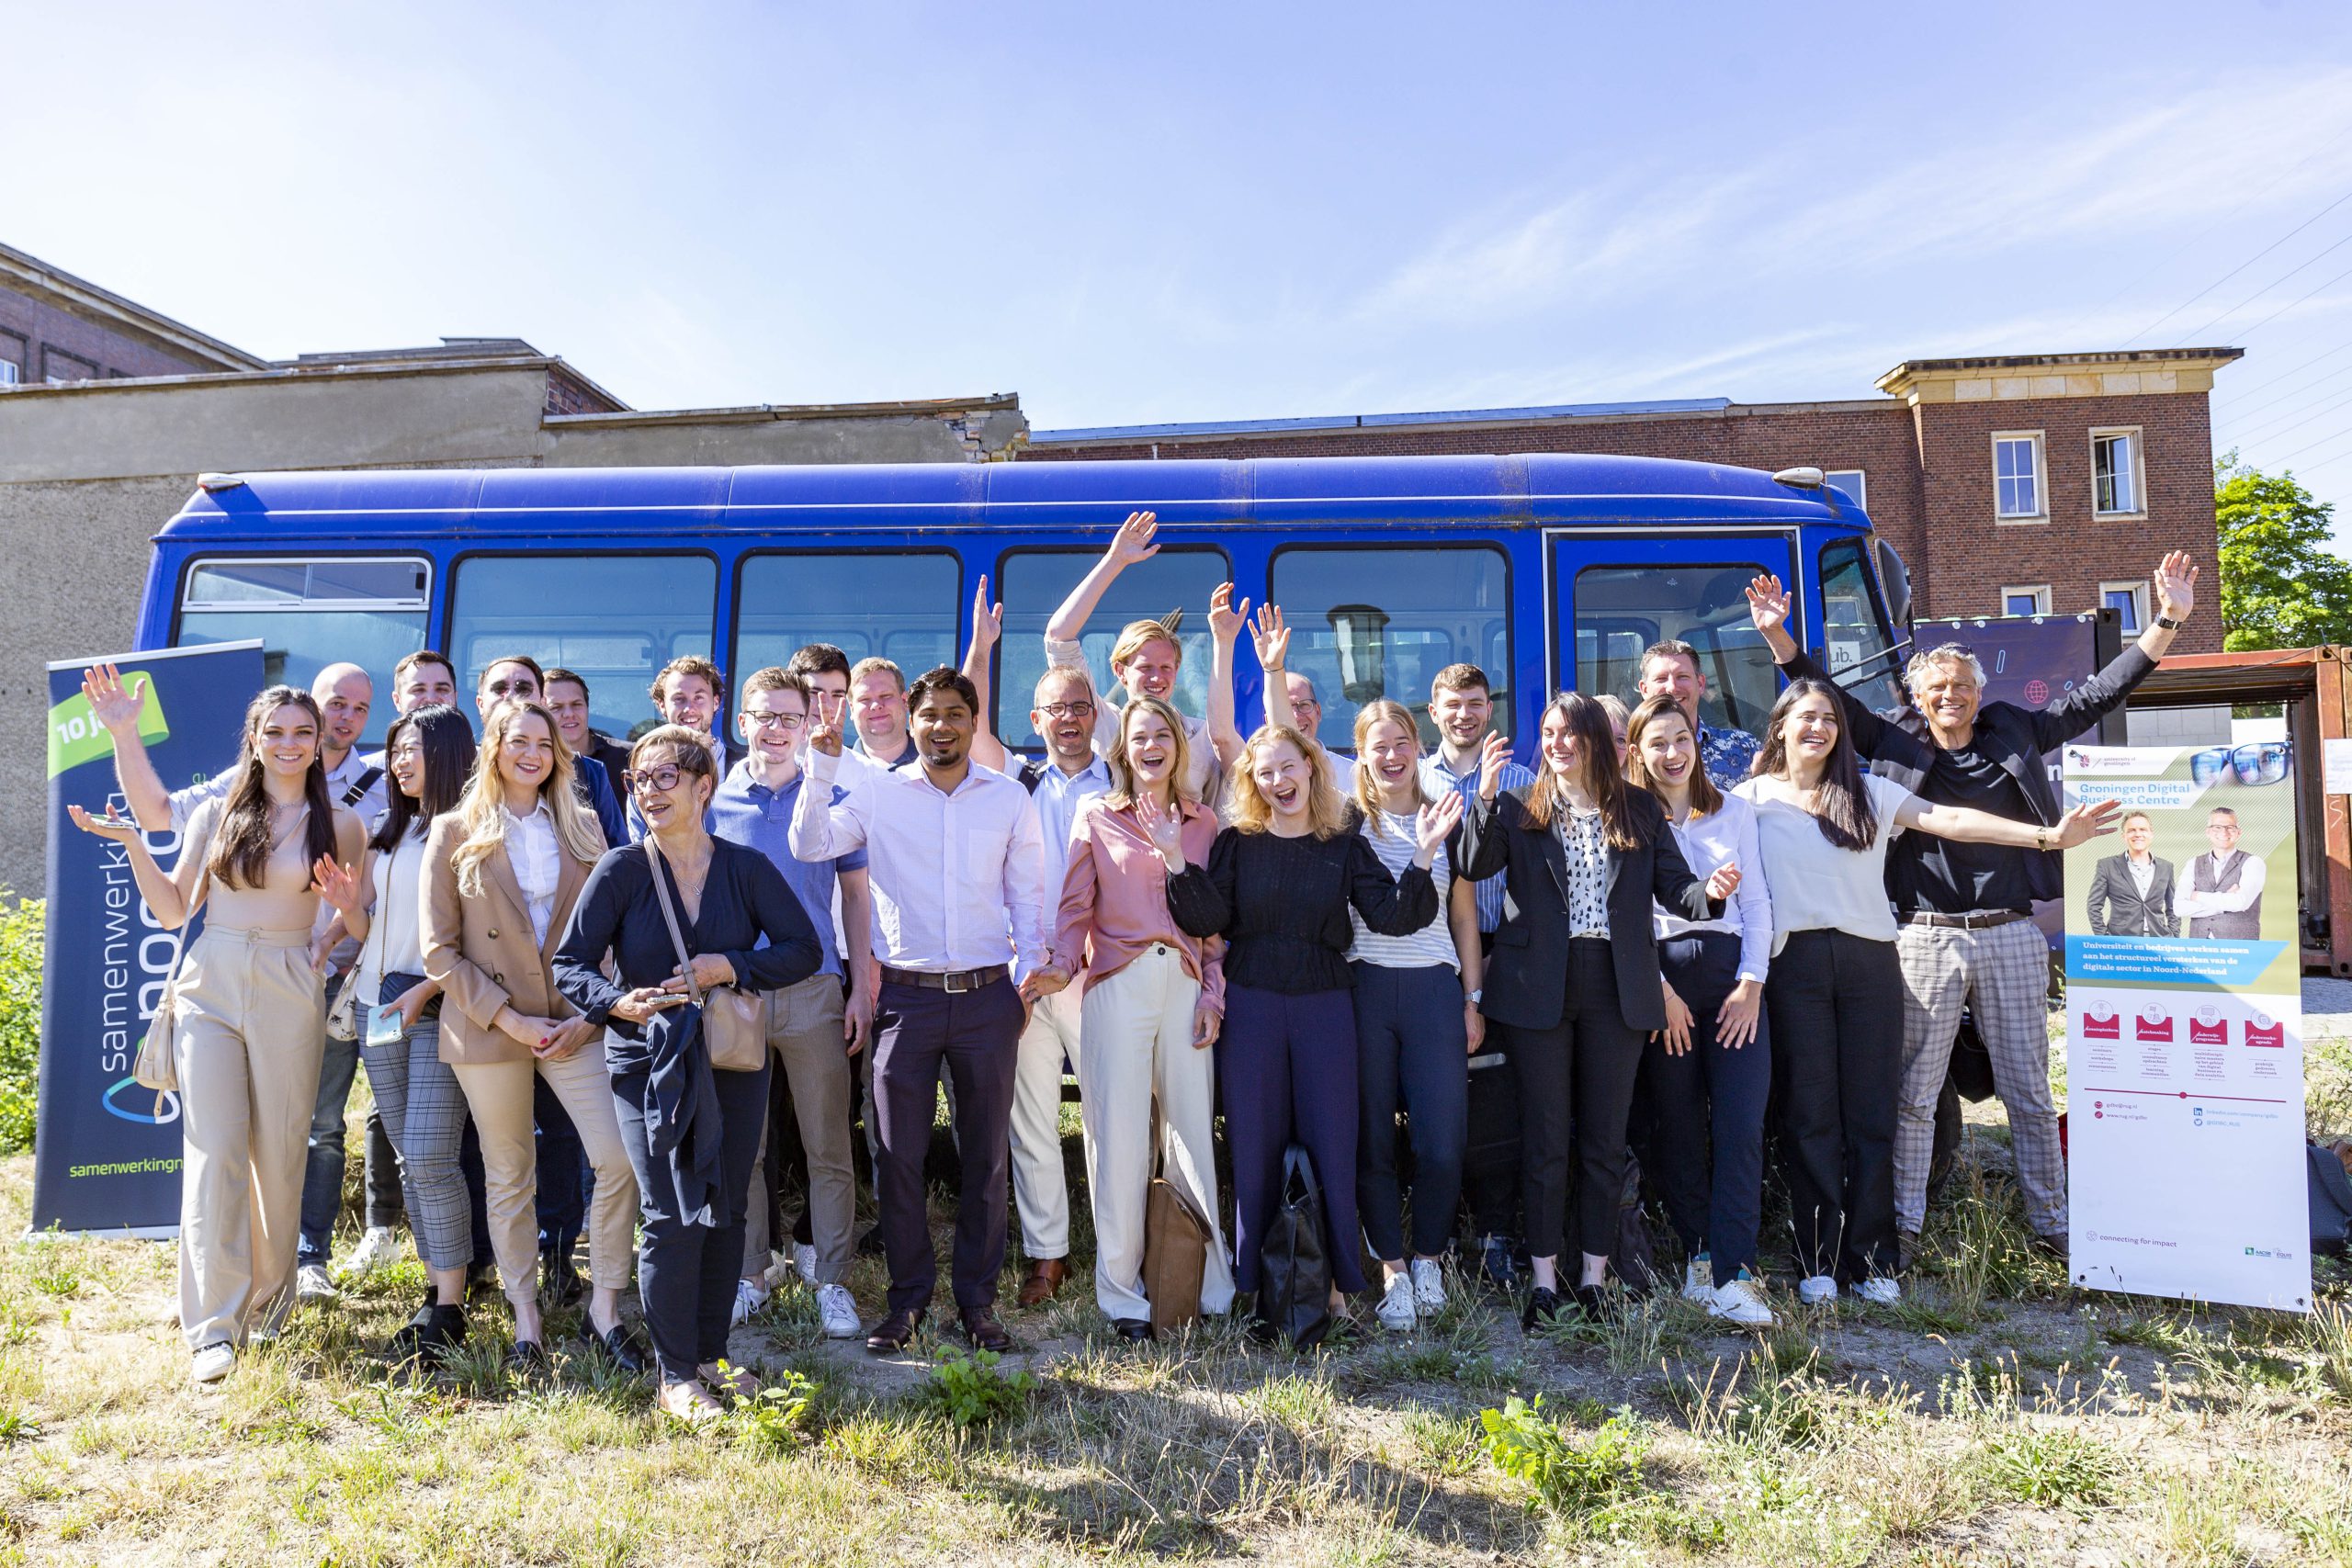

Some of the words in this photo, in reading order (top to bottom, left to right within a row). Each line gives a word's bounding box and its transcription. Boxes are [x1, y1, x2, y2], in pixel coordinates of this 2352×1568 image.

[56, 716, 85, 744] 10
[2080, 784, 2145, 795] Groningen
[2148, 784, 2190, 795] Digital
[2137, 795, 2180, 805] Centre
[2083, 942, 2132, 951] Universiteit
[2145, 943, 2186, 953] bedrijven
[2115, 953, 2162, 962] structureel
[2083, 963, 2115, 972] digitale
[2143, 964, 2152, 973] in
[2153, 965, 2228, 976] Noord-Nederland
[2099, 1235, 2139, 1245] connecting
[2140, 1236, 2151, 1245] for
[2152, 1238, 2177, 1248] impact
